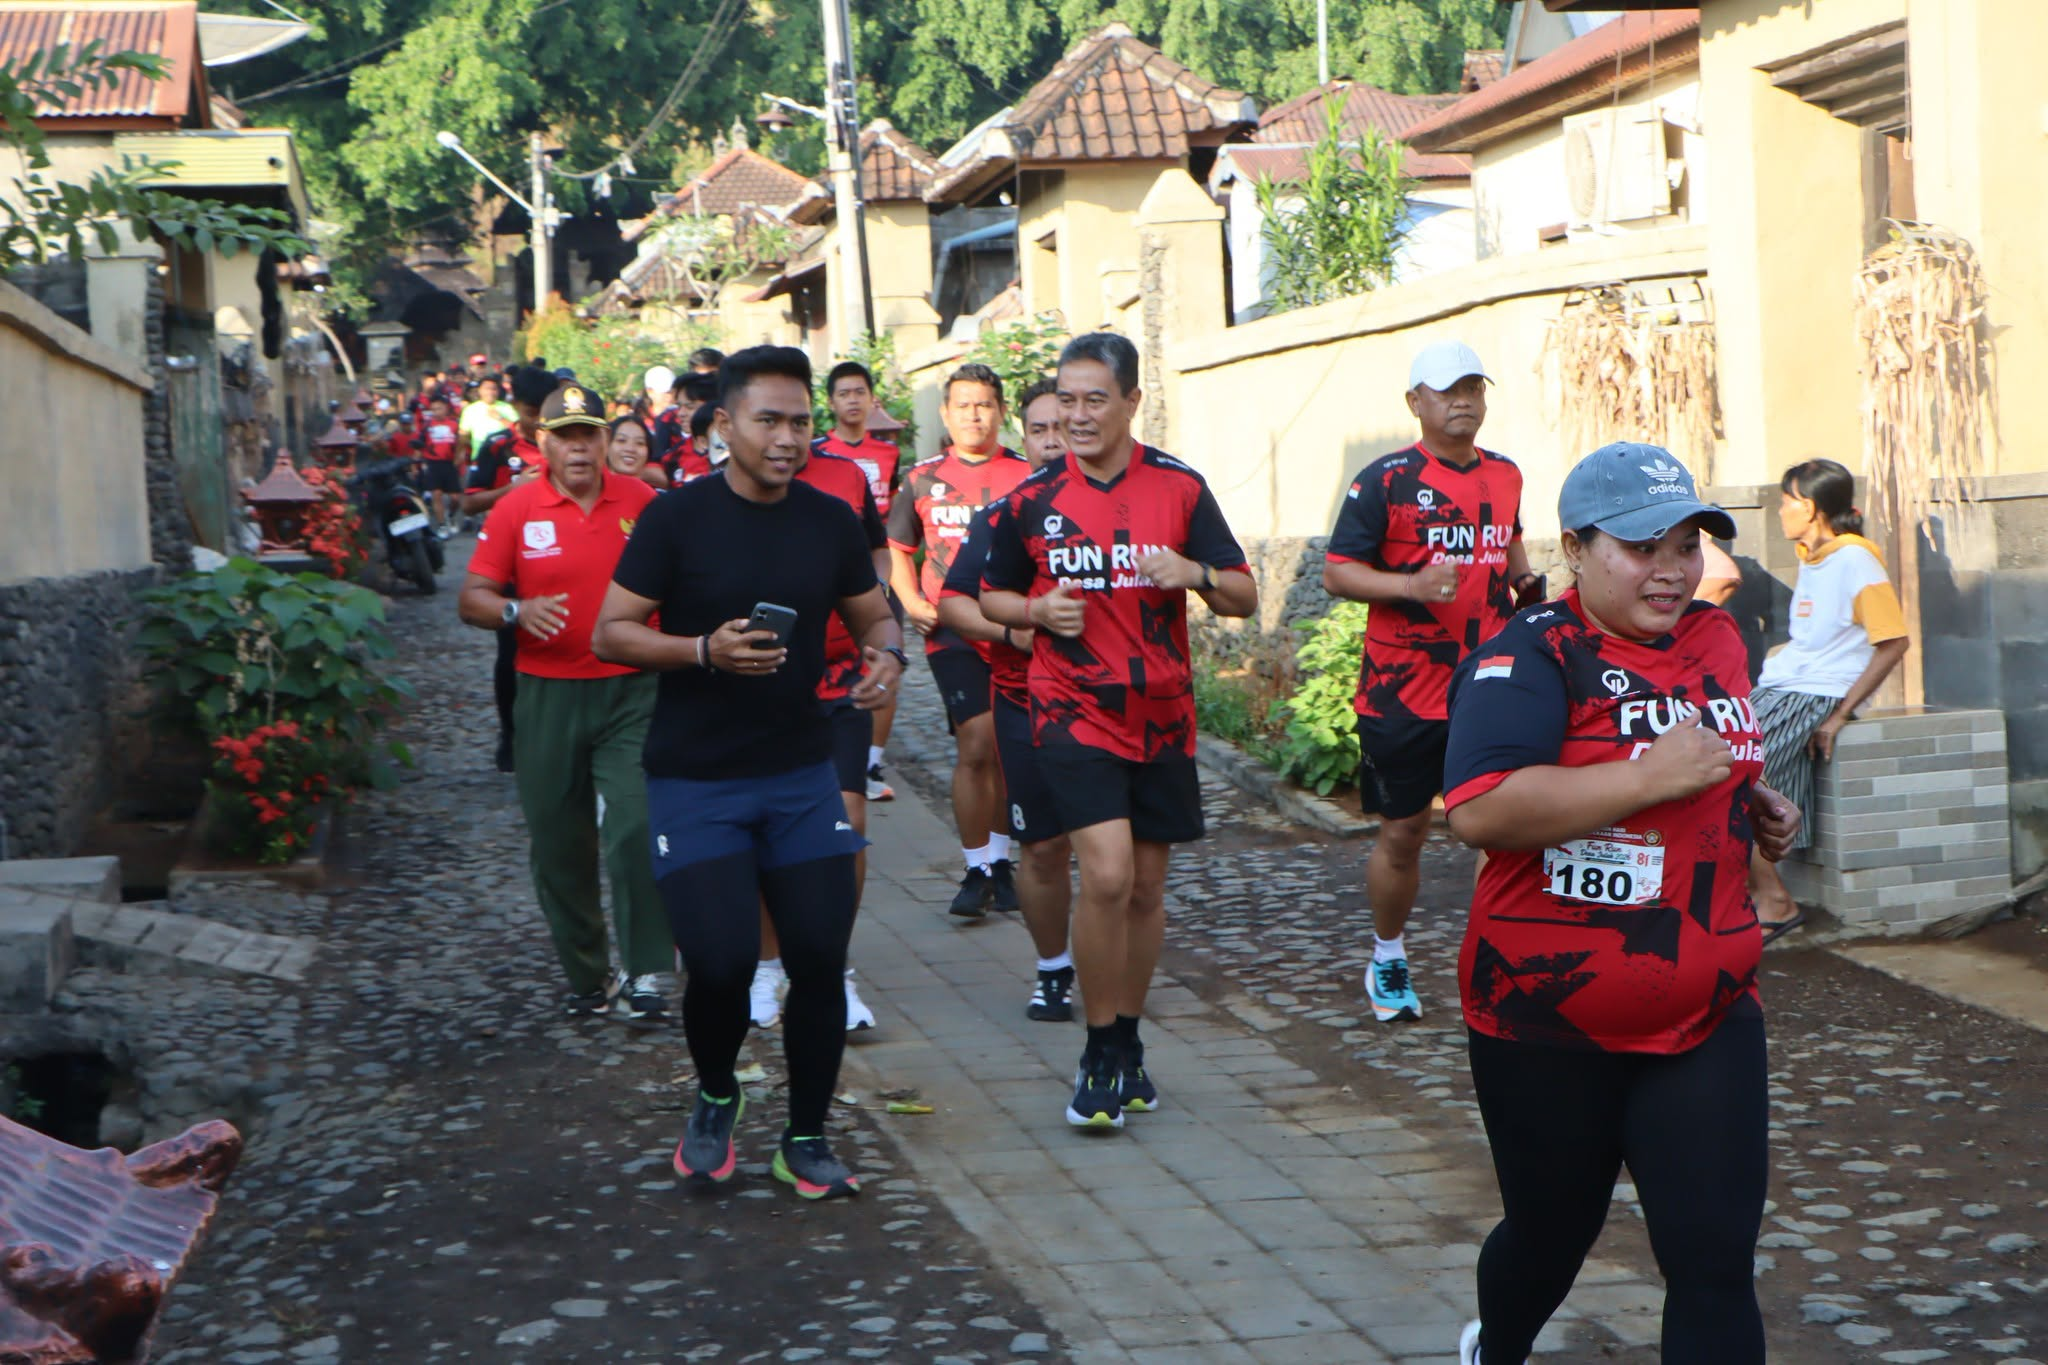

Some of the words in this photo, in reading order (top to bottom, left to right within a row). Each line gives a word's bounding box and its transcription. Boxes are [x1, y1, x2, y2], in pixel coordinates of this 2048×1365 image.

[1647, 482, 1689, 495] adidas
[930, 505, 971, 526] FUN
[1427, 525, 1475, 550] FUN
[1049, 545, 1103, 575] FUN
[1586, 841, 1601, 850] Fun
[1604, 842, 1622, 852] Run
[1556, 864, 1632, 902] 180
